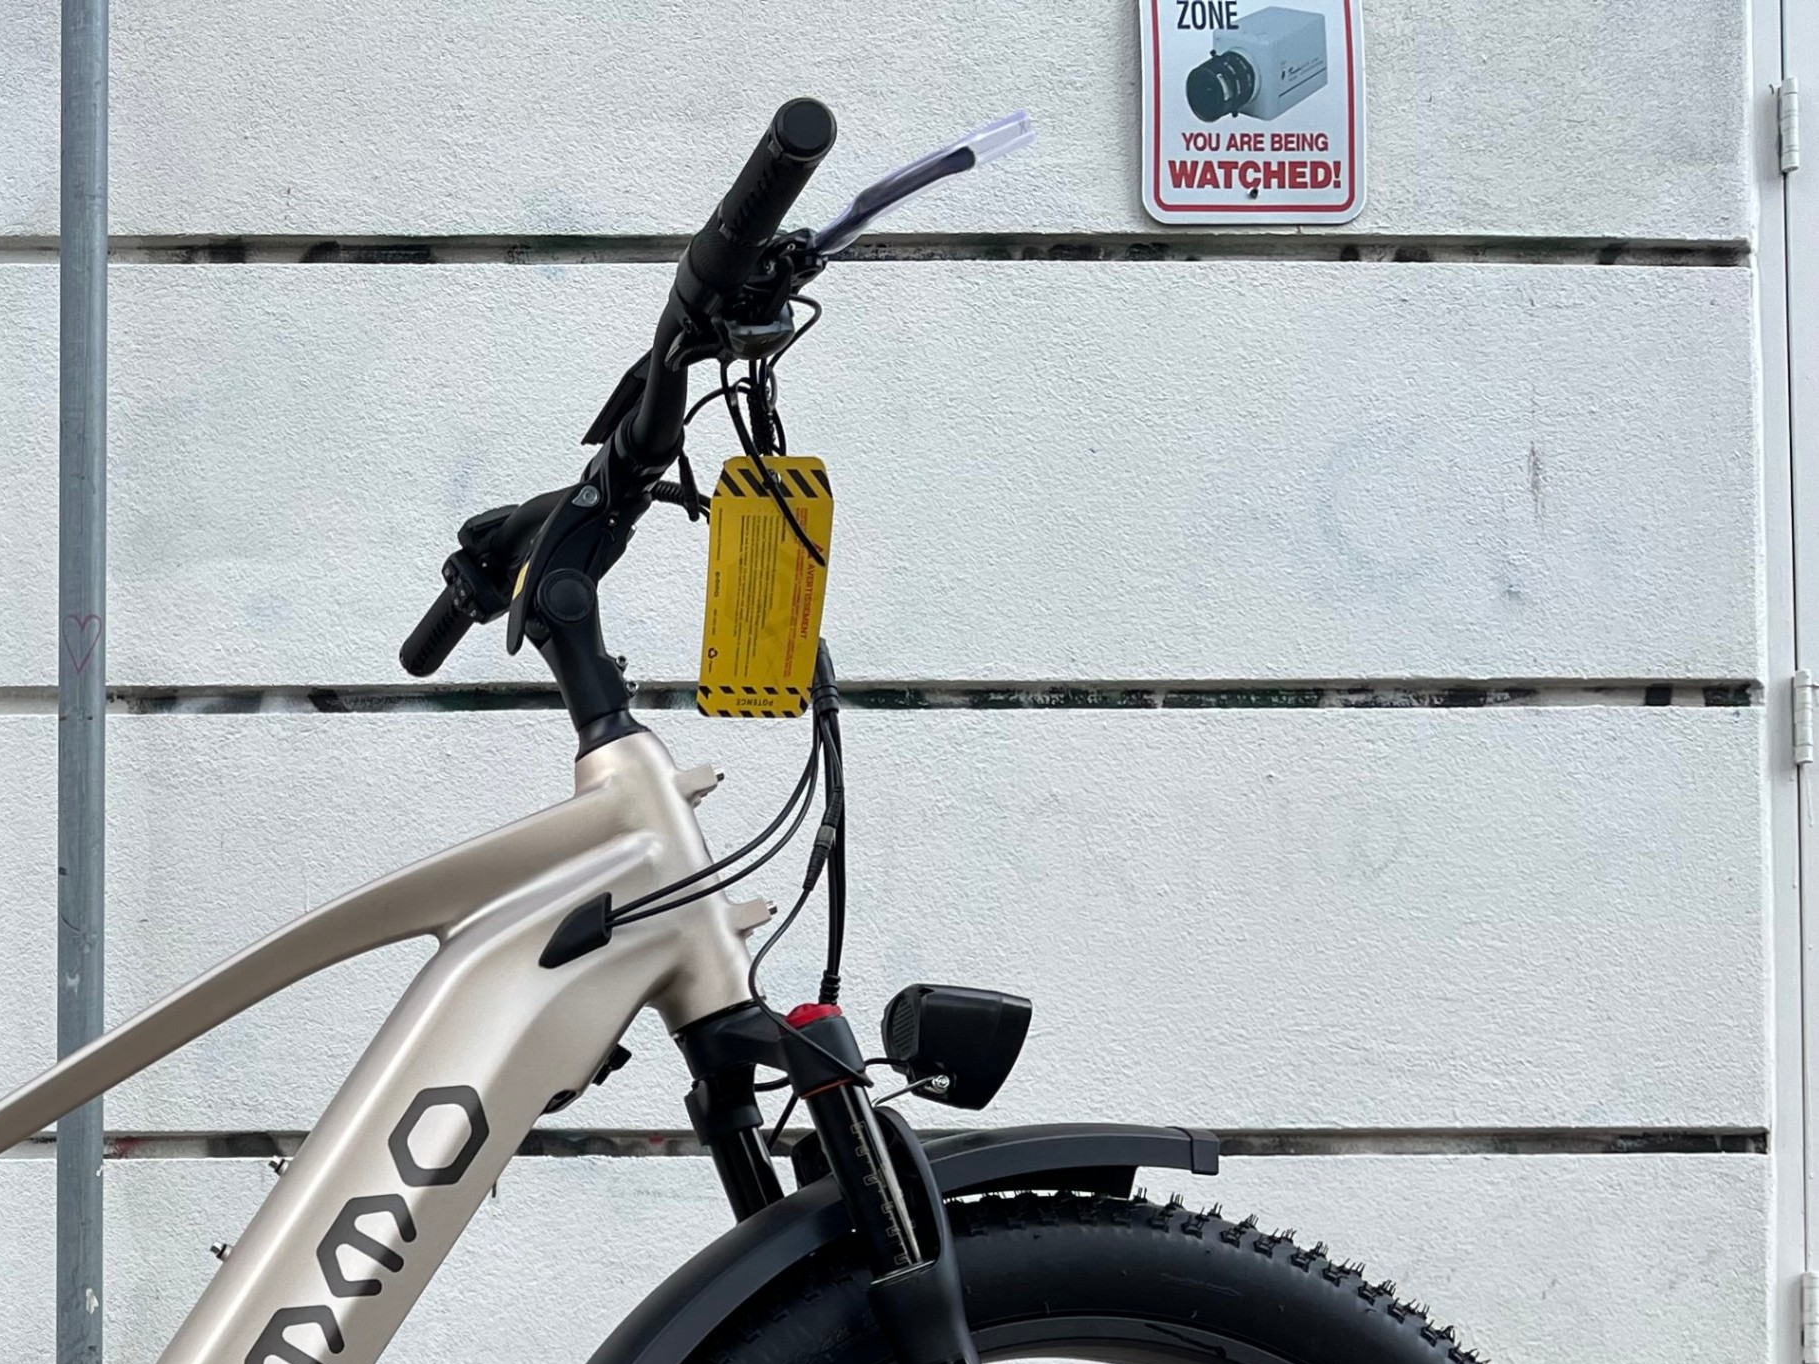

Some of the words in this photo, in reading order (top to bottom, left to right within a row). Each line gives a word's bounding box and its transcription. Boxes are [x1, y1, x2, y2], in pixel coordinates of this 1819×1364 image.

[1177, 0, 1239, 30] ZONE
[1182, 133, 1220, 152] YOU
[1226, 133, 1264, 152] ARE
[1270, 133, 1329, 152] BEING
[1168, 160, 1342, 189] WATCHED!
[800, 563, 816, 640] AVERTISSEMENT
